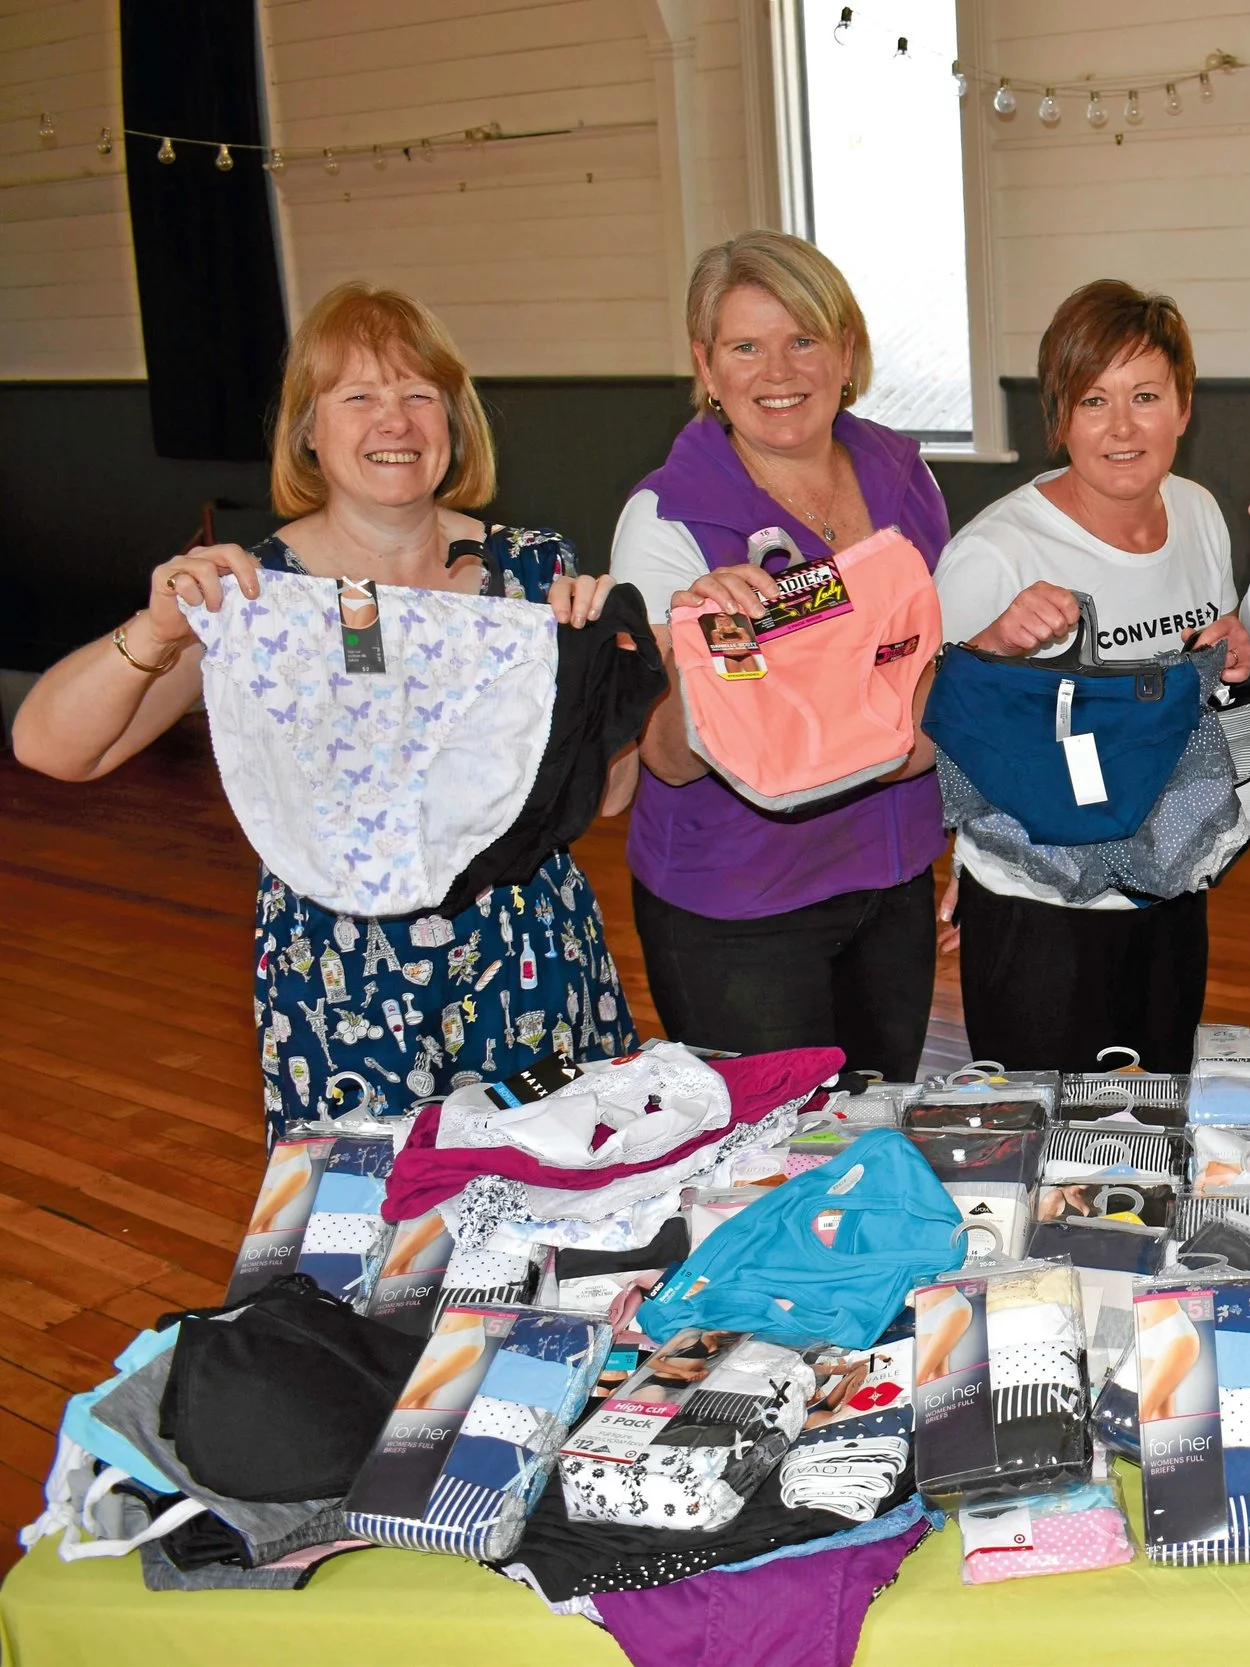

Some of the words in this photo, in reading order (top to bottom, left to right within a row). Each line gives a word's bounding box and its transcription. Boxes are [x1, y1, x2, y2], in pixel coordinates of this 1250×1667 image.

[760, 529, 770, 537] 16
[814, 579, 843, 608] Lady
[1098, 608, 1206, 649] CONVERSE
[520, 1070, 549, 1097] MAXX
[244, 1245, 268, 1260] for
[269, 1243, 296, 1257] her
[239, 1267, 260, 1275] BRIEFS
[241, 1260, 268, 1268] WOMENS
[380, 1289, 402, 1302] for
[403, 1285, 434, 1298] her
[650, 1281, 665, 1297] anko
[377, 1301, 406, 1310] WOMENS
[406, 1299, 421, 1307] FULL
[1187, 1300, 1203, 1319] 5
[375, 1308, 396, 1316] BRIEFS
[486, 1319, 504, 1334] 5
[924, 1389, 948, 1410] for
[952, 1381, 983, 1401] her
[614, 1402, 644, 1414] High
[645, 1405, 668, 1414] cut
[925, 1404, 956, 1419] WOMENS
[957, 1398, 976, 1408] FULL
[601, 1415, 611, 1424] 5
[613, 1417, 656, 1429] Pack
[924, 1412, 949, 1425] BRIEFS
[391, 1424, 417, 1440] for
[417, 1424, 451, 1441] her
[387, 1440, 418, 1448] WOMENS
[573, 1438, 594, 1450] $12
[1148, 1437, 1175, 1457] for
[1178, 1434, 1213, 1451] her
[1150, 1456, 1185, 1468] WOMENS
[1186, 1454, 1205, 1463] FULL
[1150, 1465, 1176, 1475] BRIEFS
